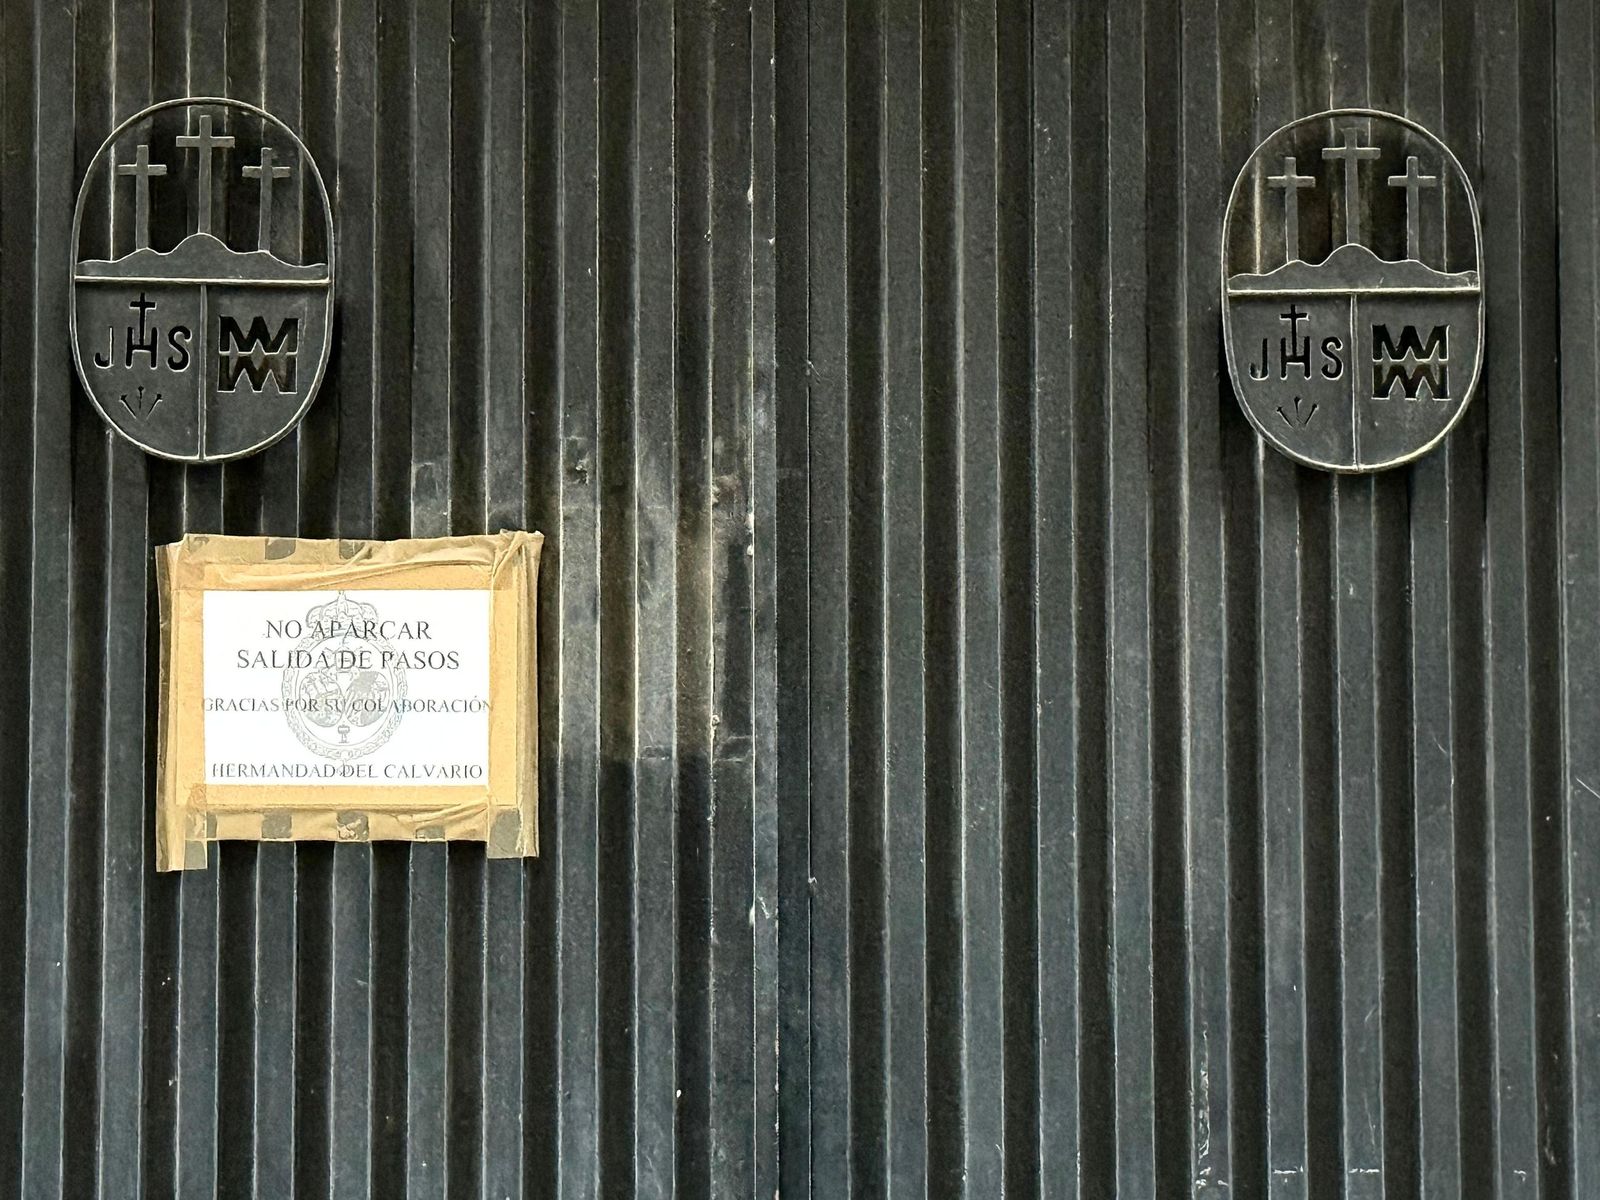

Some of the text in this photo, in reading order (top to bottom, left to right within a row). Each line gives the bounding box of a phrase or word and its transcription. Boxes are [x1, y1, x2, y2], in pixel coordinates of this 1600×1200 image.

[264, 620, 432, 640] NO APARCAR
[237, 650, 459, 669] SALIDA DE PASOS
[202, 694, 493, 712] GRACIAS POR SU COLABORACIÓN
[212, 763, 482, 778] HERMANDAD DEL CALVARIO
